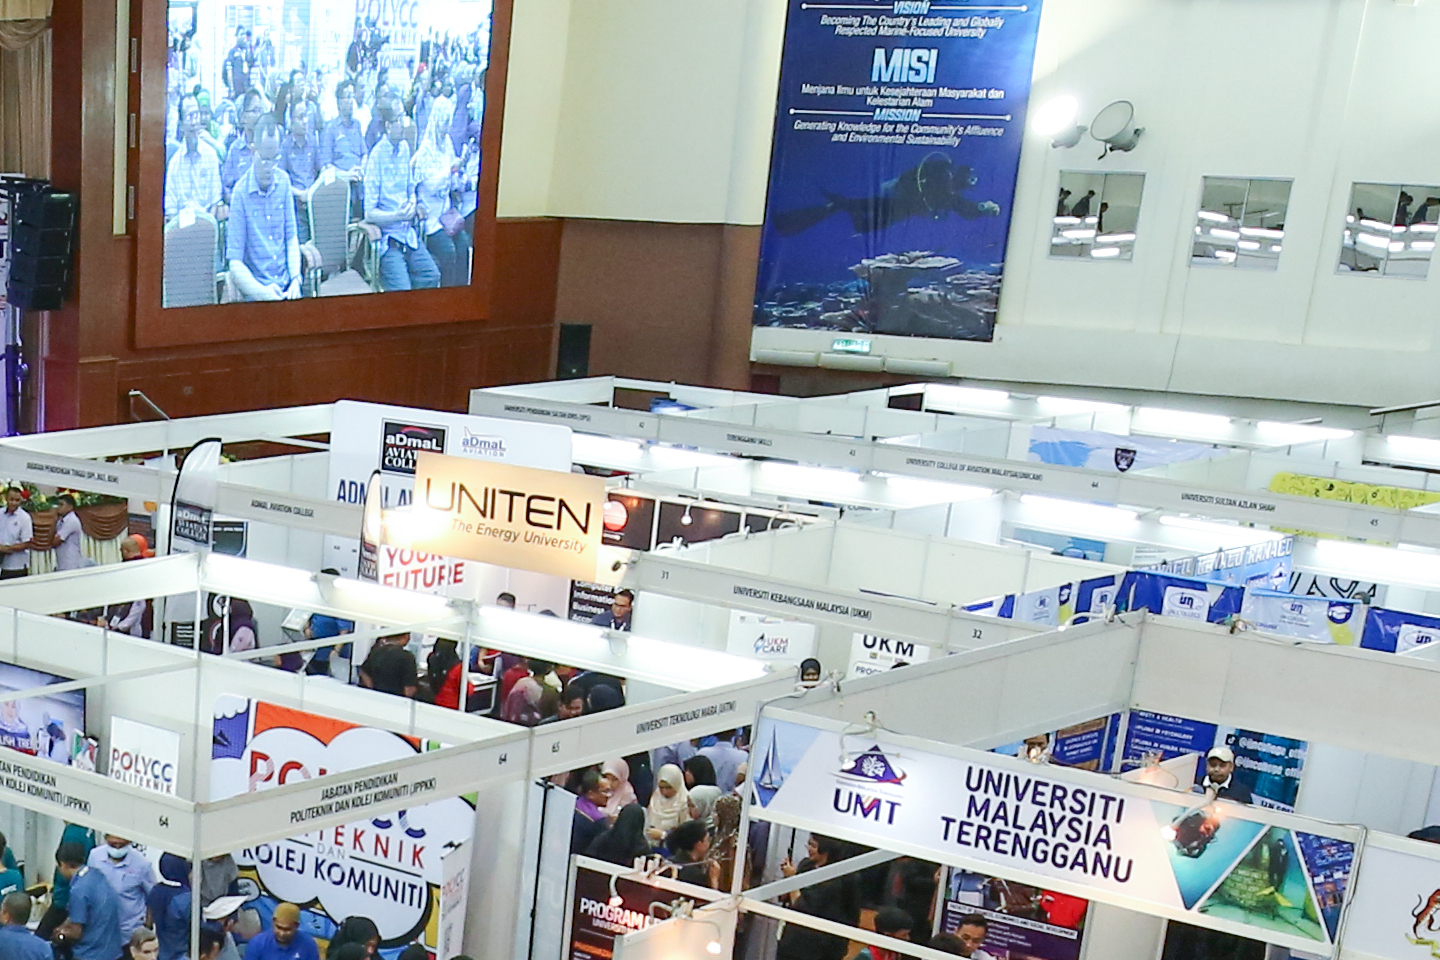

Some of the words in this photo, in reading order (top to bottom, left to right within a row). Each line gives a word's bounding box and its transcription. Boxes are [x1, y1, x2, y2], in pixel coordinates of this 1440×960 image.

[893, 1, 930, 15] VISION
[872, 48, 938, 84] MISI
[801, 83, 835, 96] Menjana
[836, 84, 854, 95] Ilmu
[855, 86, 879, 96] untuk
[880, 86, 937, 98] Kesejahteraan
[938, 87, 987, 100] Masyarakat
[988, 89, 1004, 99] dan
[873, 108, 922, 122] MISSION
[424, 477, 592, 535] UNITEN
[451, 516, 474, 536] The
[475, 523, 520, 545] Energy
[523, 529, 587, 554] University
[383, 562, 465, 588] FUTURE
[733, 584, 770, 602] UNIVERSITI
[770, 591, 815, 611] KEBANGSAAN
[816, 597, 850, 616] MALAYSIA
[850, 602, 873, 622] (UKM)
[761, 643, 790, 656] CARE
[862, 633, 916, 658] UKM
[971, 627, 983, 640] 32
[12, 761, 57, 789] PENDIDIKAN
[111, 746, 174, 784] POLYCC
[320, 781, 352, 801] JABATAN
[352, 771, 398, 795] PENDIDIKAN
[965, 765, 1125, 824] UNIVERSITI
[832, 787, 902, 825] UMT
[965, 794, 1113, 851] MALAYSIA
[941, 815, 1134, 883] TERENGGANU
[241, 843, 305, 876] KOLEJ
[314, 860, 424, 910] KOMUNITI
[580, 896, 641, 931] PROGRAM
